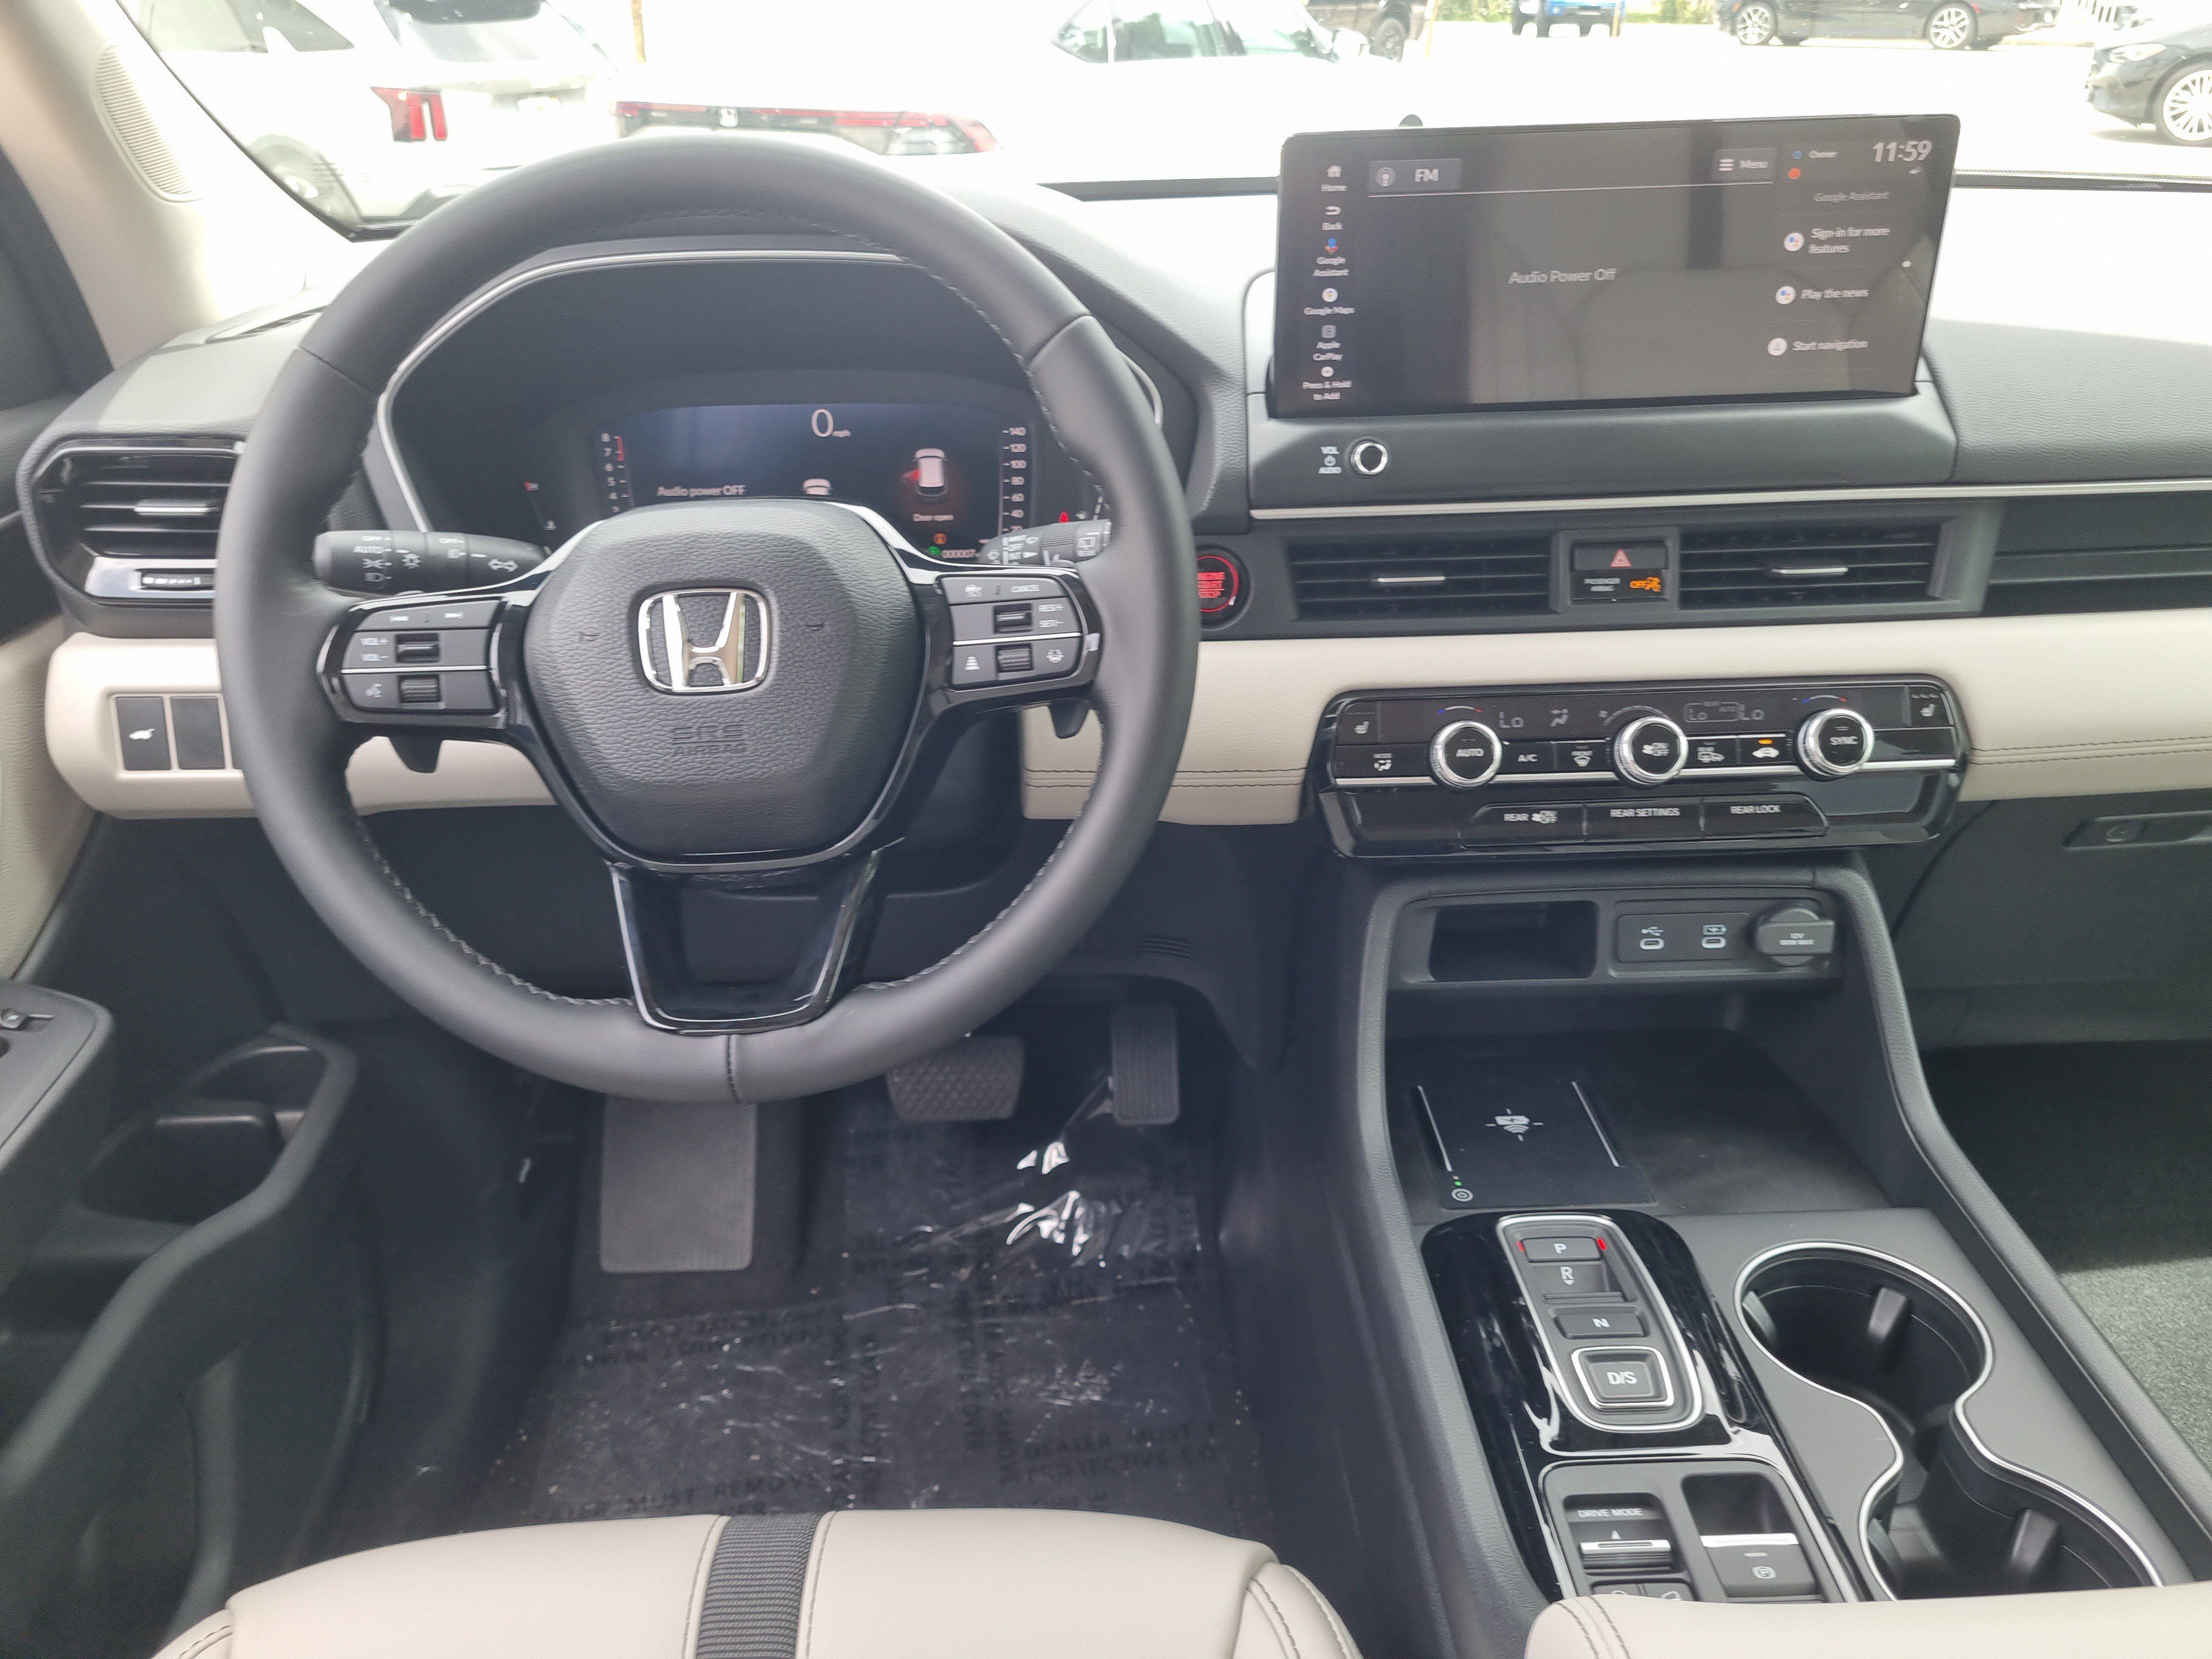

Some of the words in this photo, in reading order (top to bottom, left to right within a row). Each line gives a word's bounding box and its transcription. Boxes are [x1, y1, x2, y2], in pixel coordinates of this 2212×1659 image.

[1873, 140, 1932, 162] 11:59
[1739, 160, 1768, 169] Menu
[1414, 168, 1439, 182] FM
[1322, 222, 1343, 230] Back
[1847, 227, 1862, 237] for
[1809, 244, 1849, 254] features
[1508, 272, 1548, 284] Audio
[1549, 270, 1593, 282] Power
[1593, 268, 1617, 280] Off
[1801, 289, 1822, 301] Play
[1823, 289, 1841, 298] the
[1792, 341, 1816, 351] Start
[1817, 340, 1868, 351] navigation
[811, 409, 833, 437] 0
[1321, 446, 1339, 454] VOL
[657, 486, 687, 496] Audio
[722, 484, 746, 495] OFF
[353, 545, 384, 554] AUTO
[1197, 572, 1225, 580] NGINE
[1011, 584, 1040, 593] CANCEL
[1830, 736, 1858, 745] SYNC
[1455, 748, 1484, 757] AUTO
[1518, 754, 1537, 762] A/C
[1610, 809, 1635, 818] REAR
[1635, 808, 1680, 817] SETTINGS
[1730, 805, 1754, 815] REAR
[1754, 804, 1781, 814] LOCK
[1504, 813, 1528, 822] REAR
[1554, 1243, 1567, 1254] P
[1560, 1266, 1574, 1280] R
[1593, 1318, 1610, 1328] N
[1606, 1372, 1638, 1385] D/S
[1577, 1509, 1610, 1518] DRIVE
[1611, 1508, 1644, 1517] MODE
